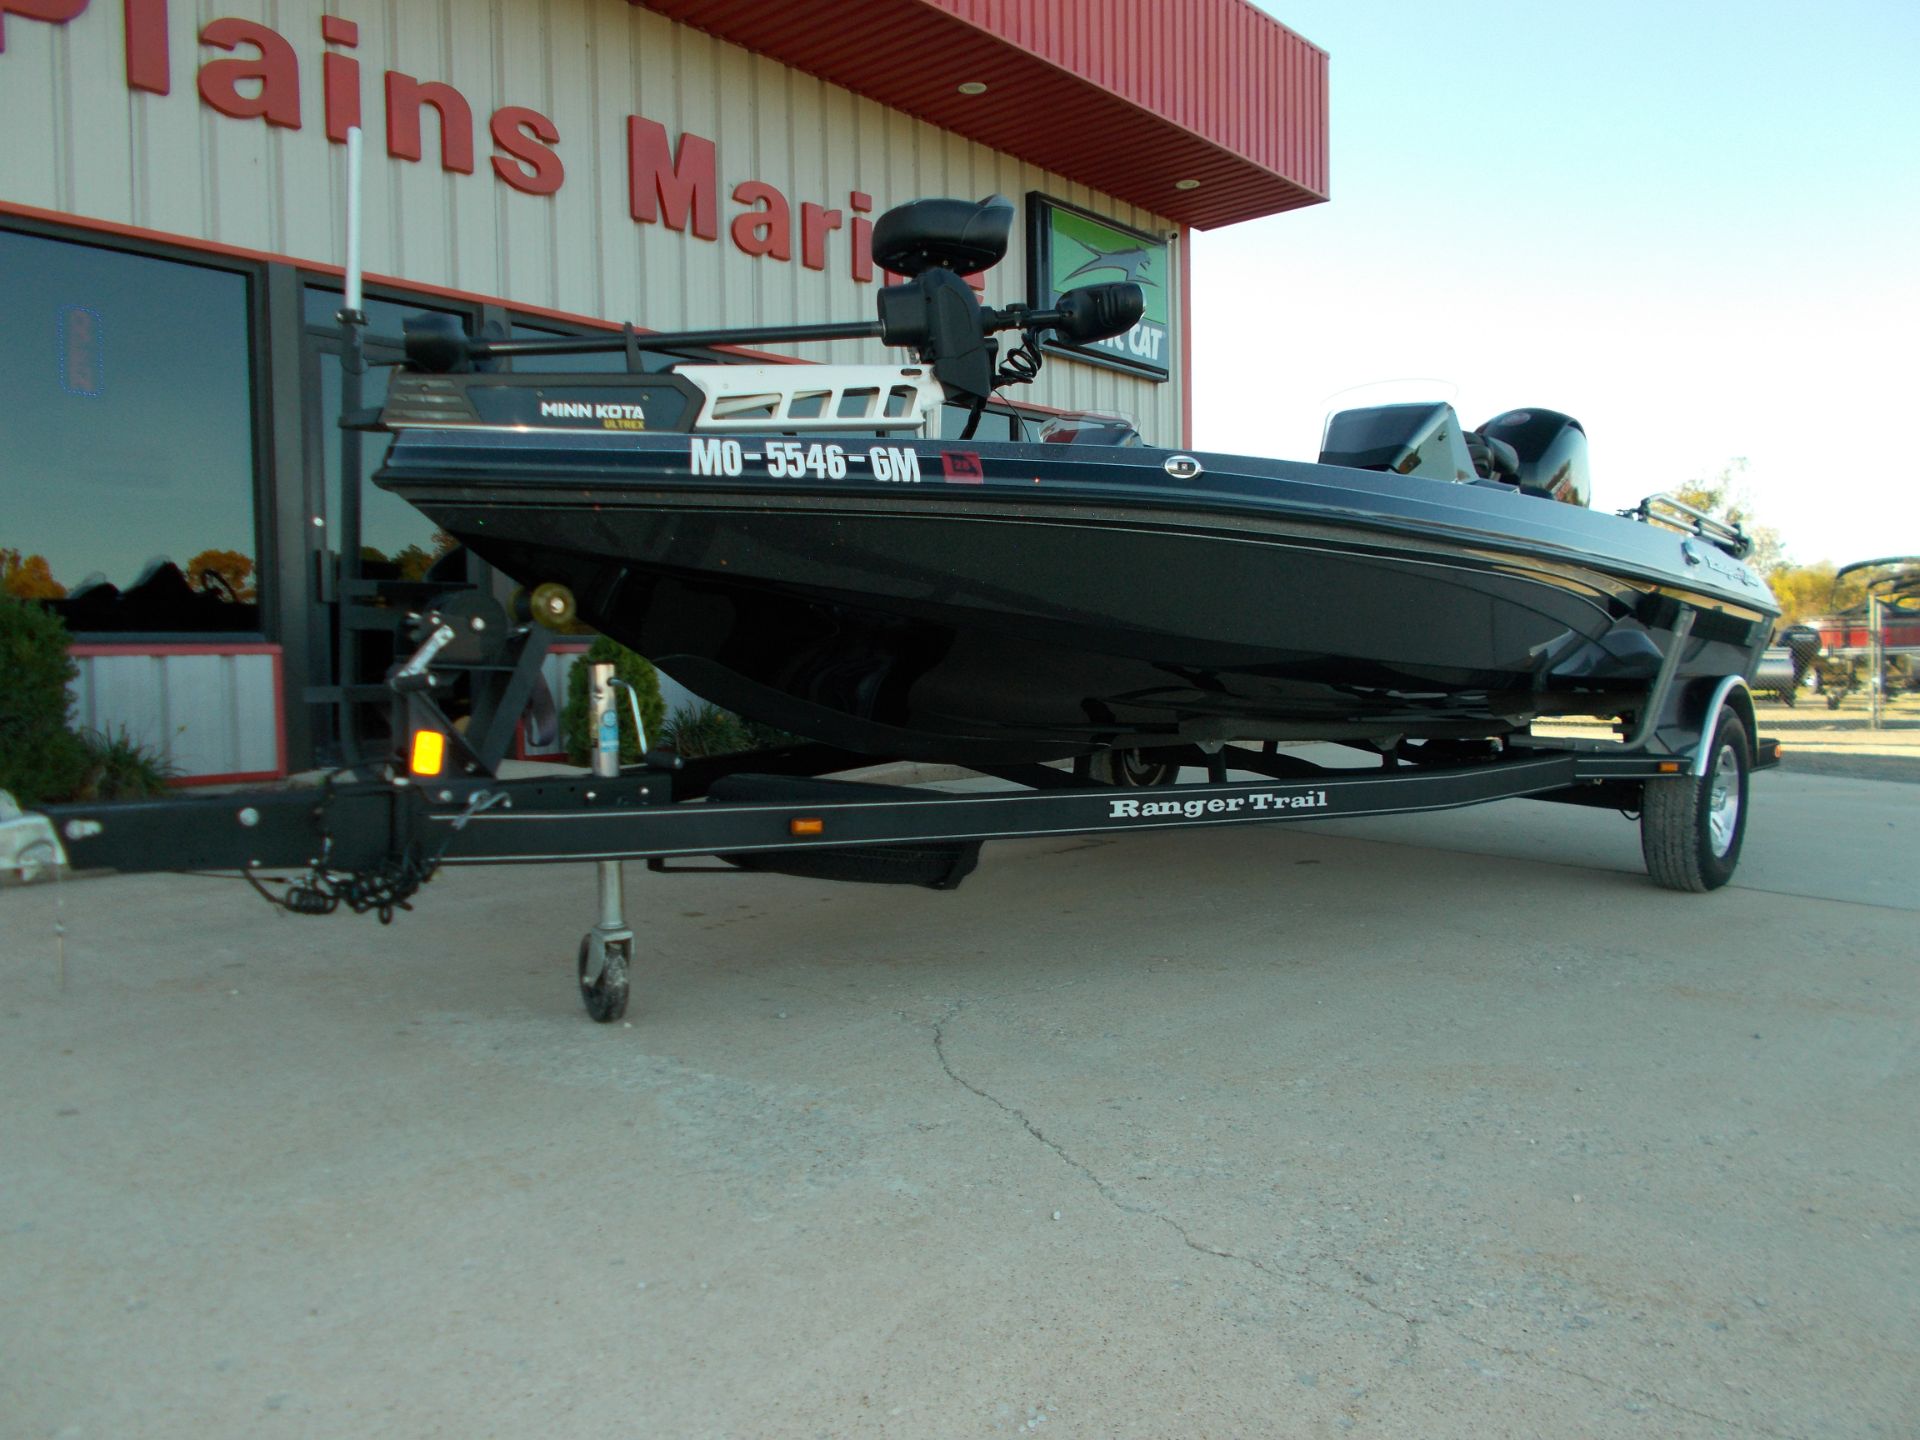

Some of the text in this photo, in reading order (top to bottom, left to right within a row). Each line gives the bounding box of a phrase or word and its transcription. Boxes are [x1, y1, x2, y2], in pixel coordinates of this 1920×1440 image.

[0, 0, 985, 304] lains Mari
[1129, 323, 1163, 361] CAT
[541, 402, 645, 419] MINN KOTA
[603, 419, 645, 430] ULTREX
[1109, 790, 1328, 819] Ranger Trail
